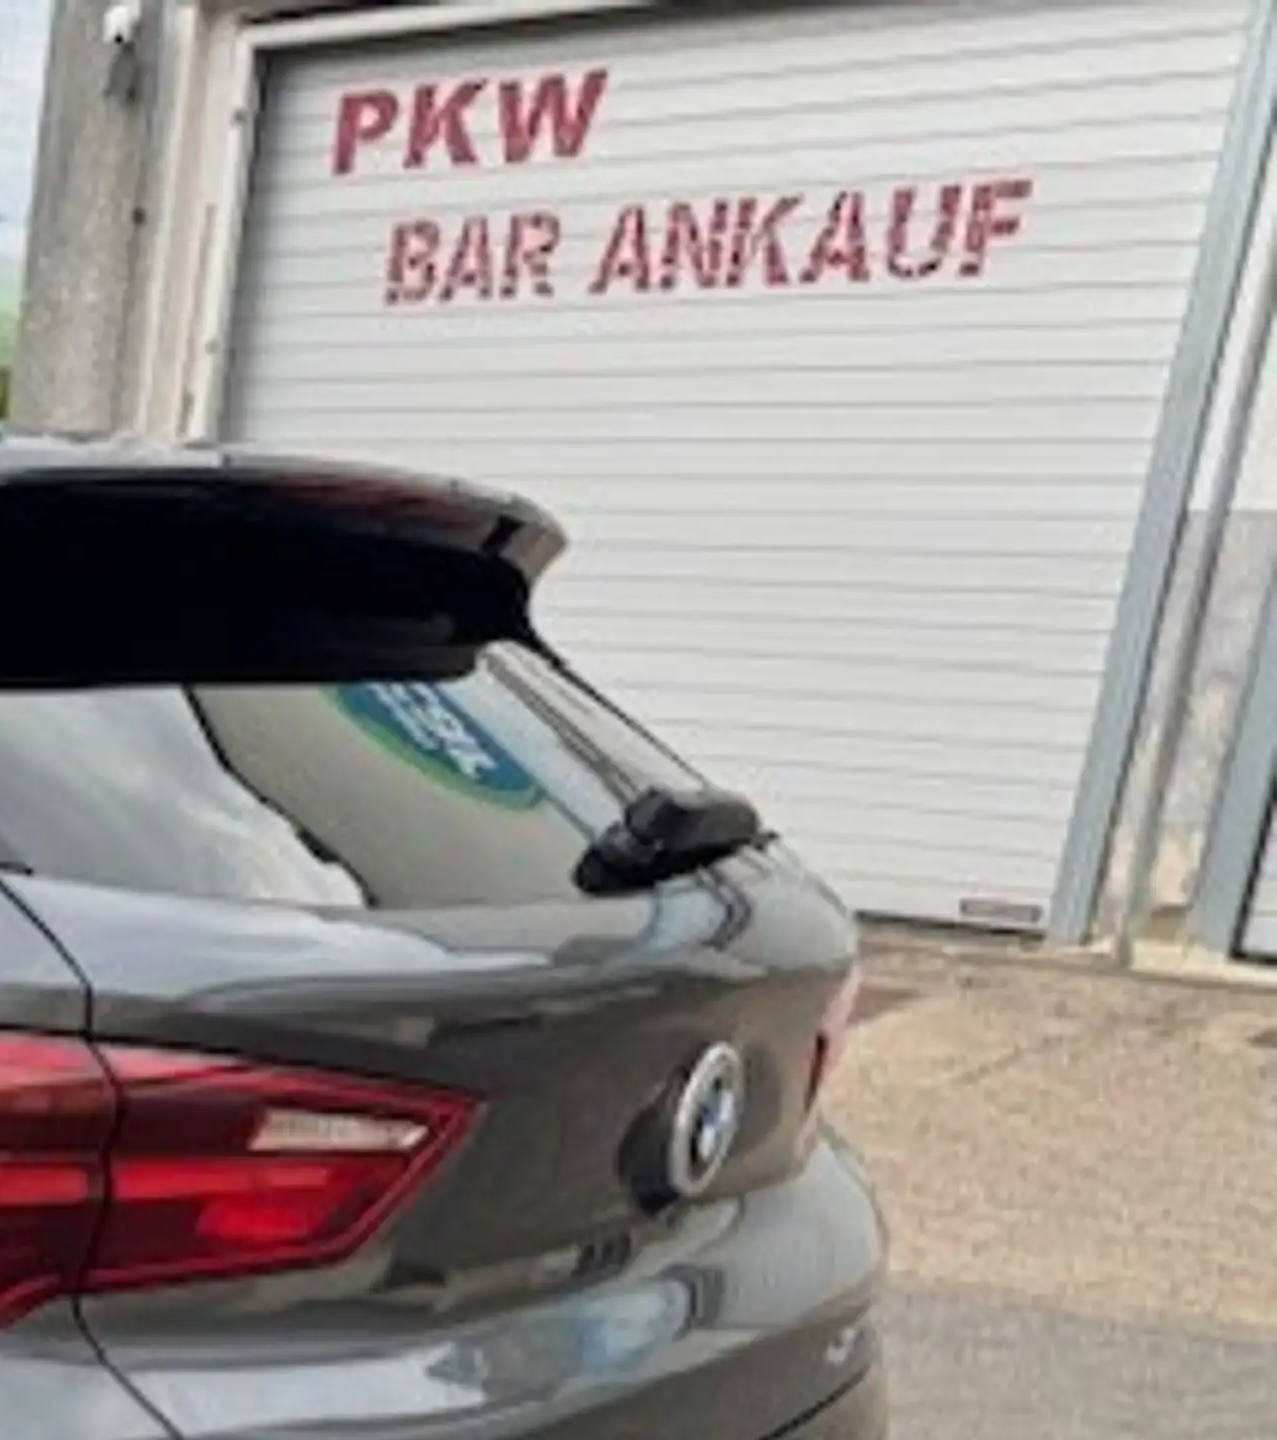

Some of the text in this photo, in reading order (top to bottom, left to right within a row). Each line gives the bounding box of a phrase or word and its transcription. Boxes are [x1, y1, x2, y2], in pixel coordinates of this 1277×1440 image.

[332, 68, 607, 175] PKW
[385, 178, 1034, 303] BAR ANKAUF
